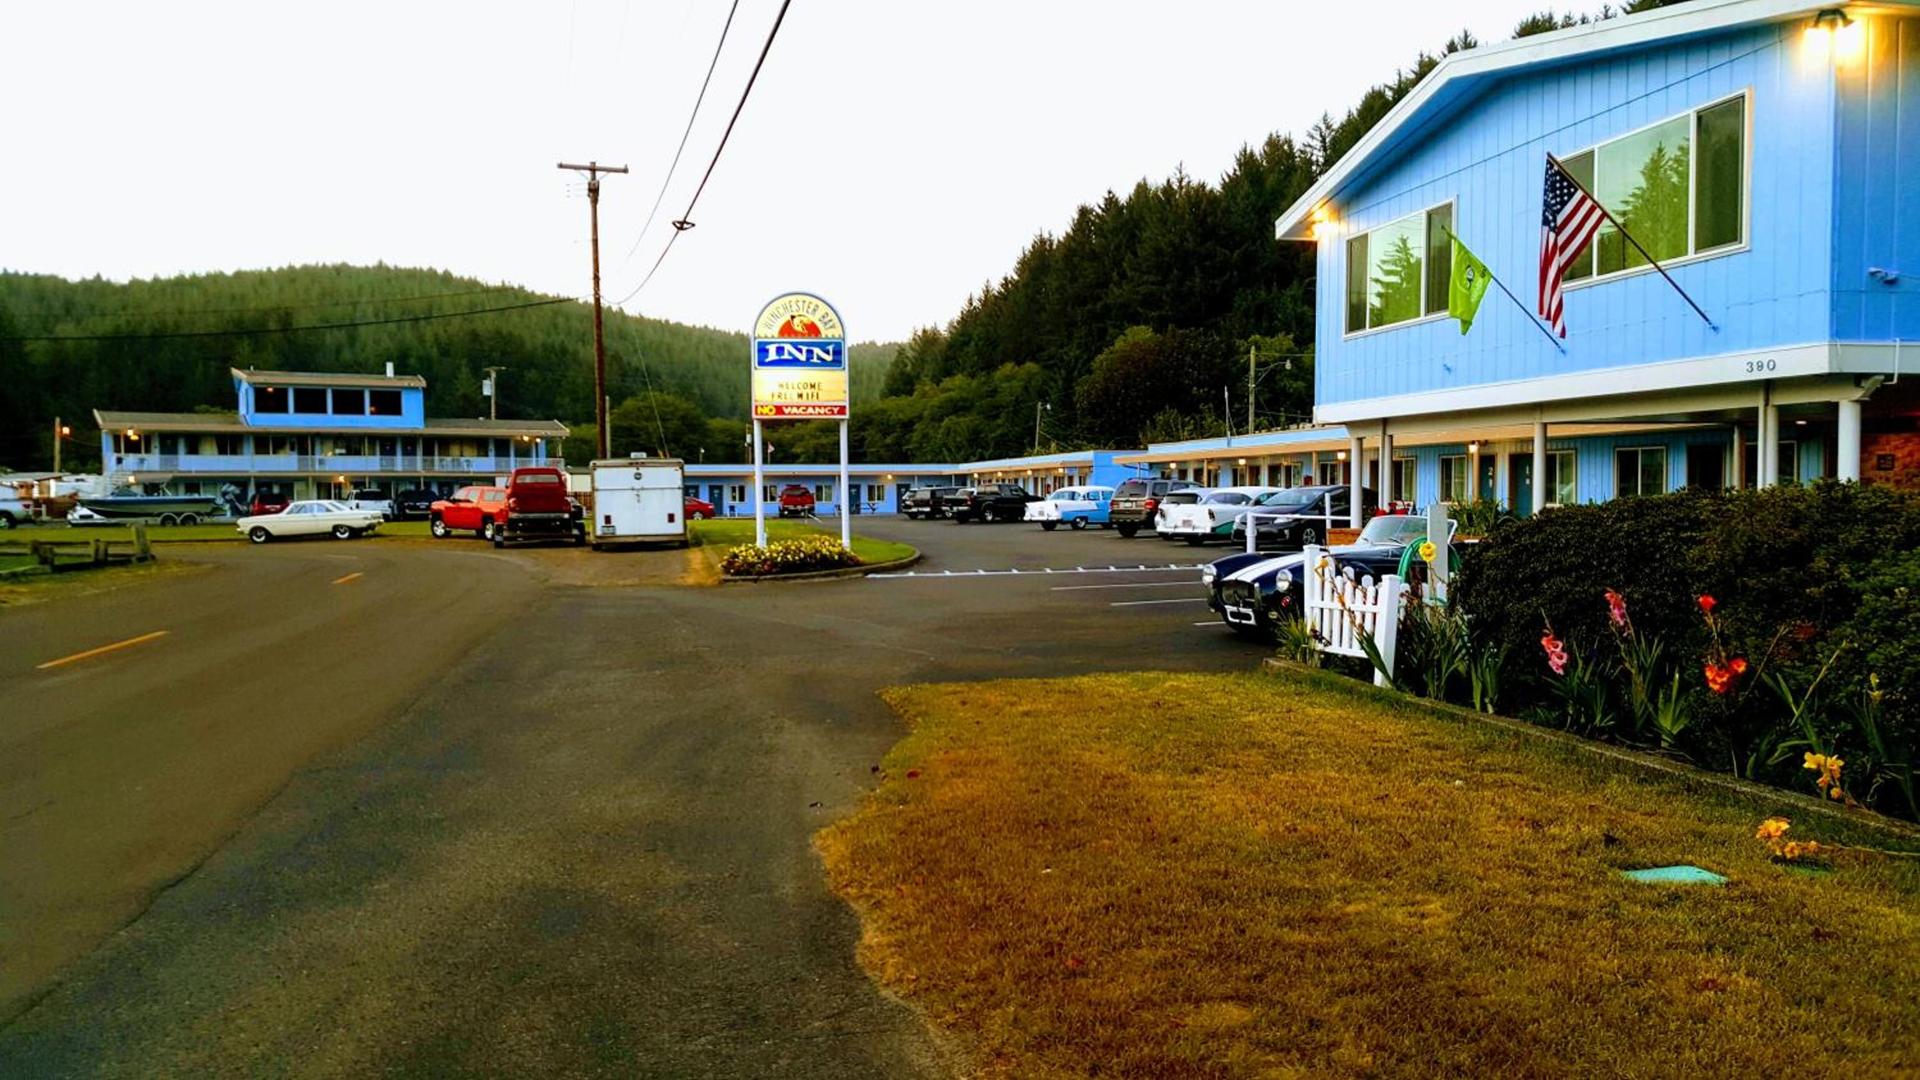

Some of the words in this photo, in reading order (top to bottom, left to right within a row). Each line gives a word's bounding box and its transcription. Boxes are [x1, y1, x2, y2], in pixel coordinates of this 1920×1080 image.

[818, 311, 837, 330] BAY
[765, 343, 835, 363] INN
[778, 382, 823, 391] WELCOME
[757, 404, 776, 416] NO
[783, 406, 840, 415] VACANCY
